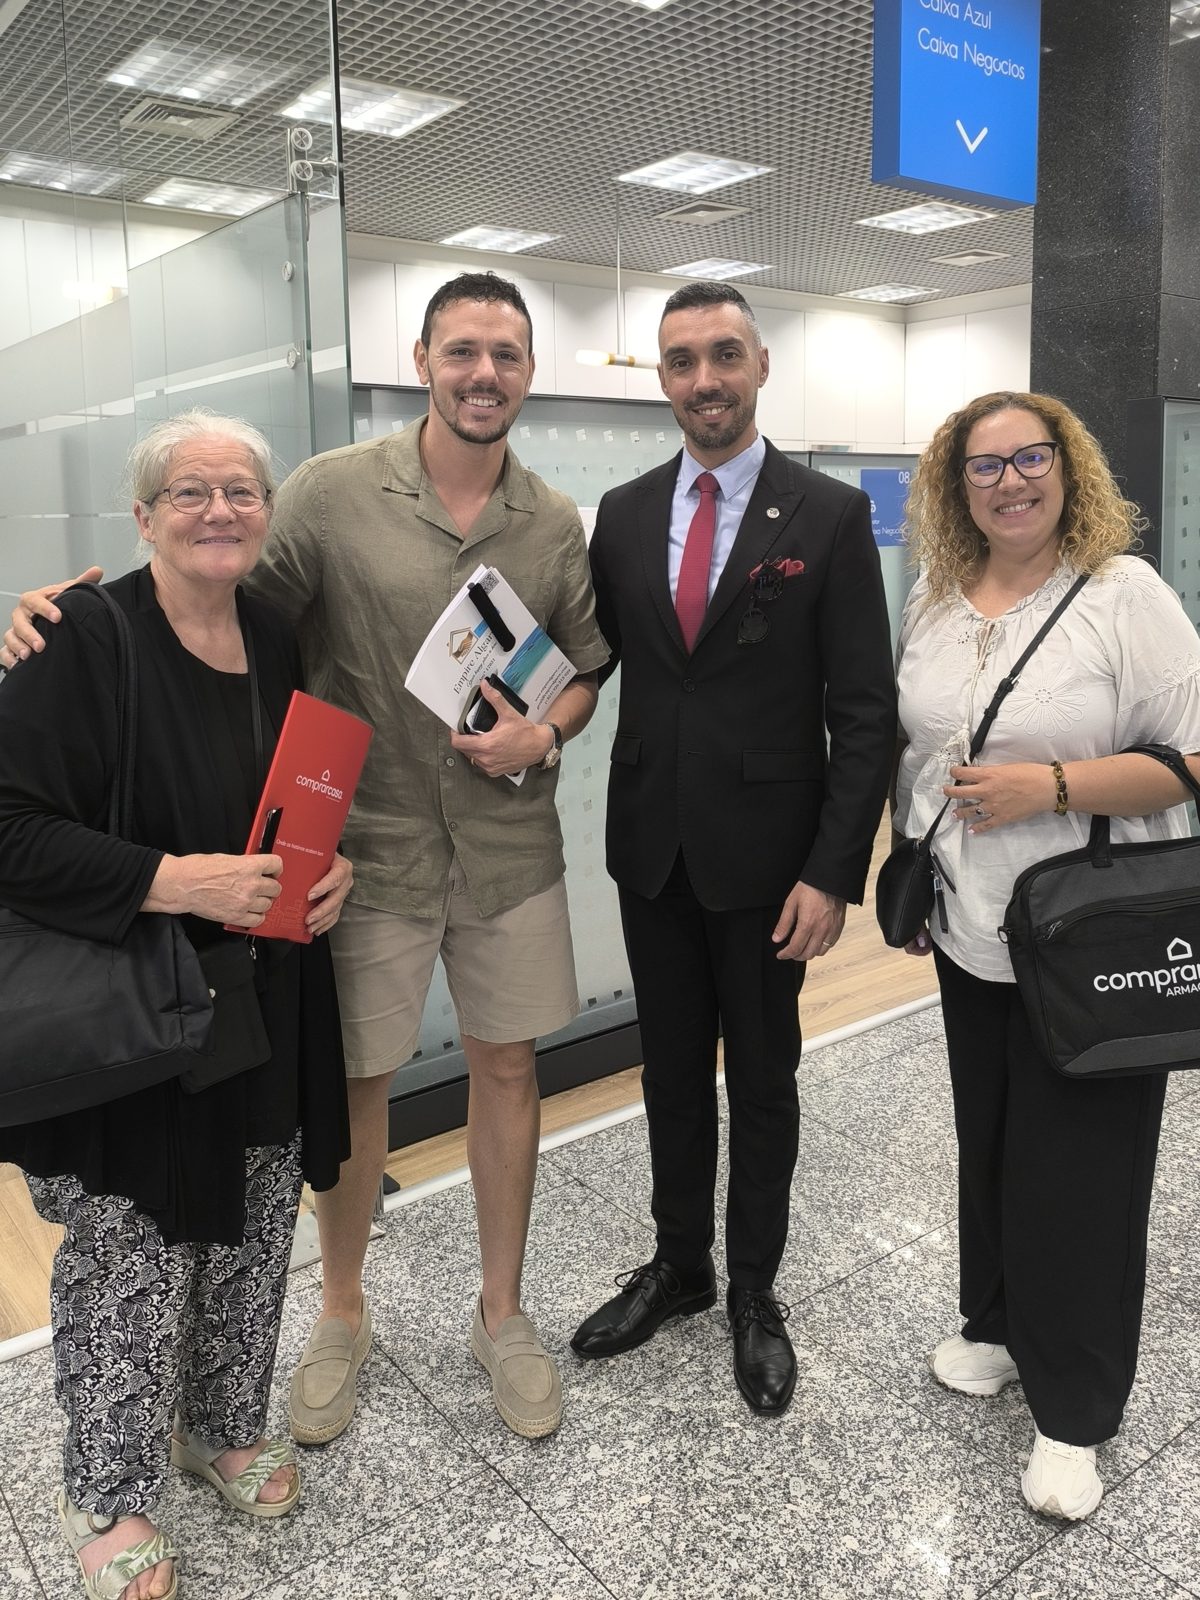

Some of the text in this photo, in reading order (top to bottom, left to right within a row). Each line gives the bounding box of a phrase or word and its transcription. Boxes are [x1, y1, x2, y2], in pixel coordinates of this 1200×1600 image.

[963, 2, 992, 30] Azul
[917, 27, 958, 60] Caixa
[898, 471, 910, 484] 08
[453, 659, 476, 695] Empire
[476, 632, 495, 660] Algar
